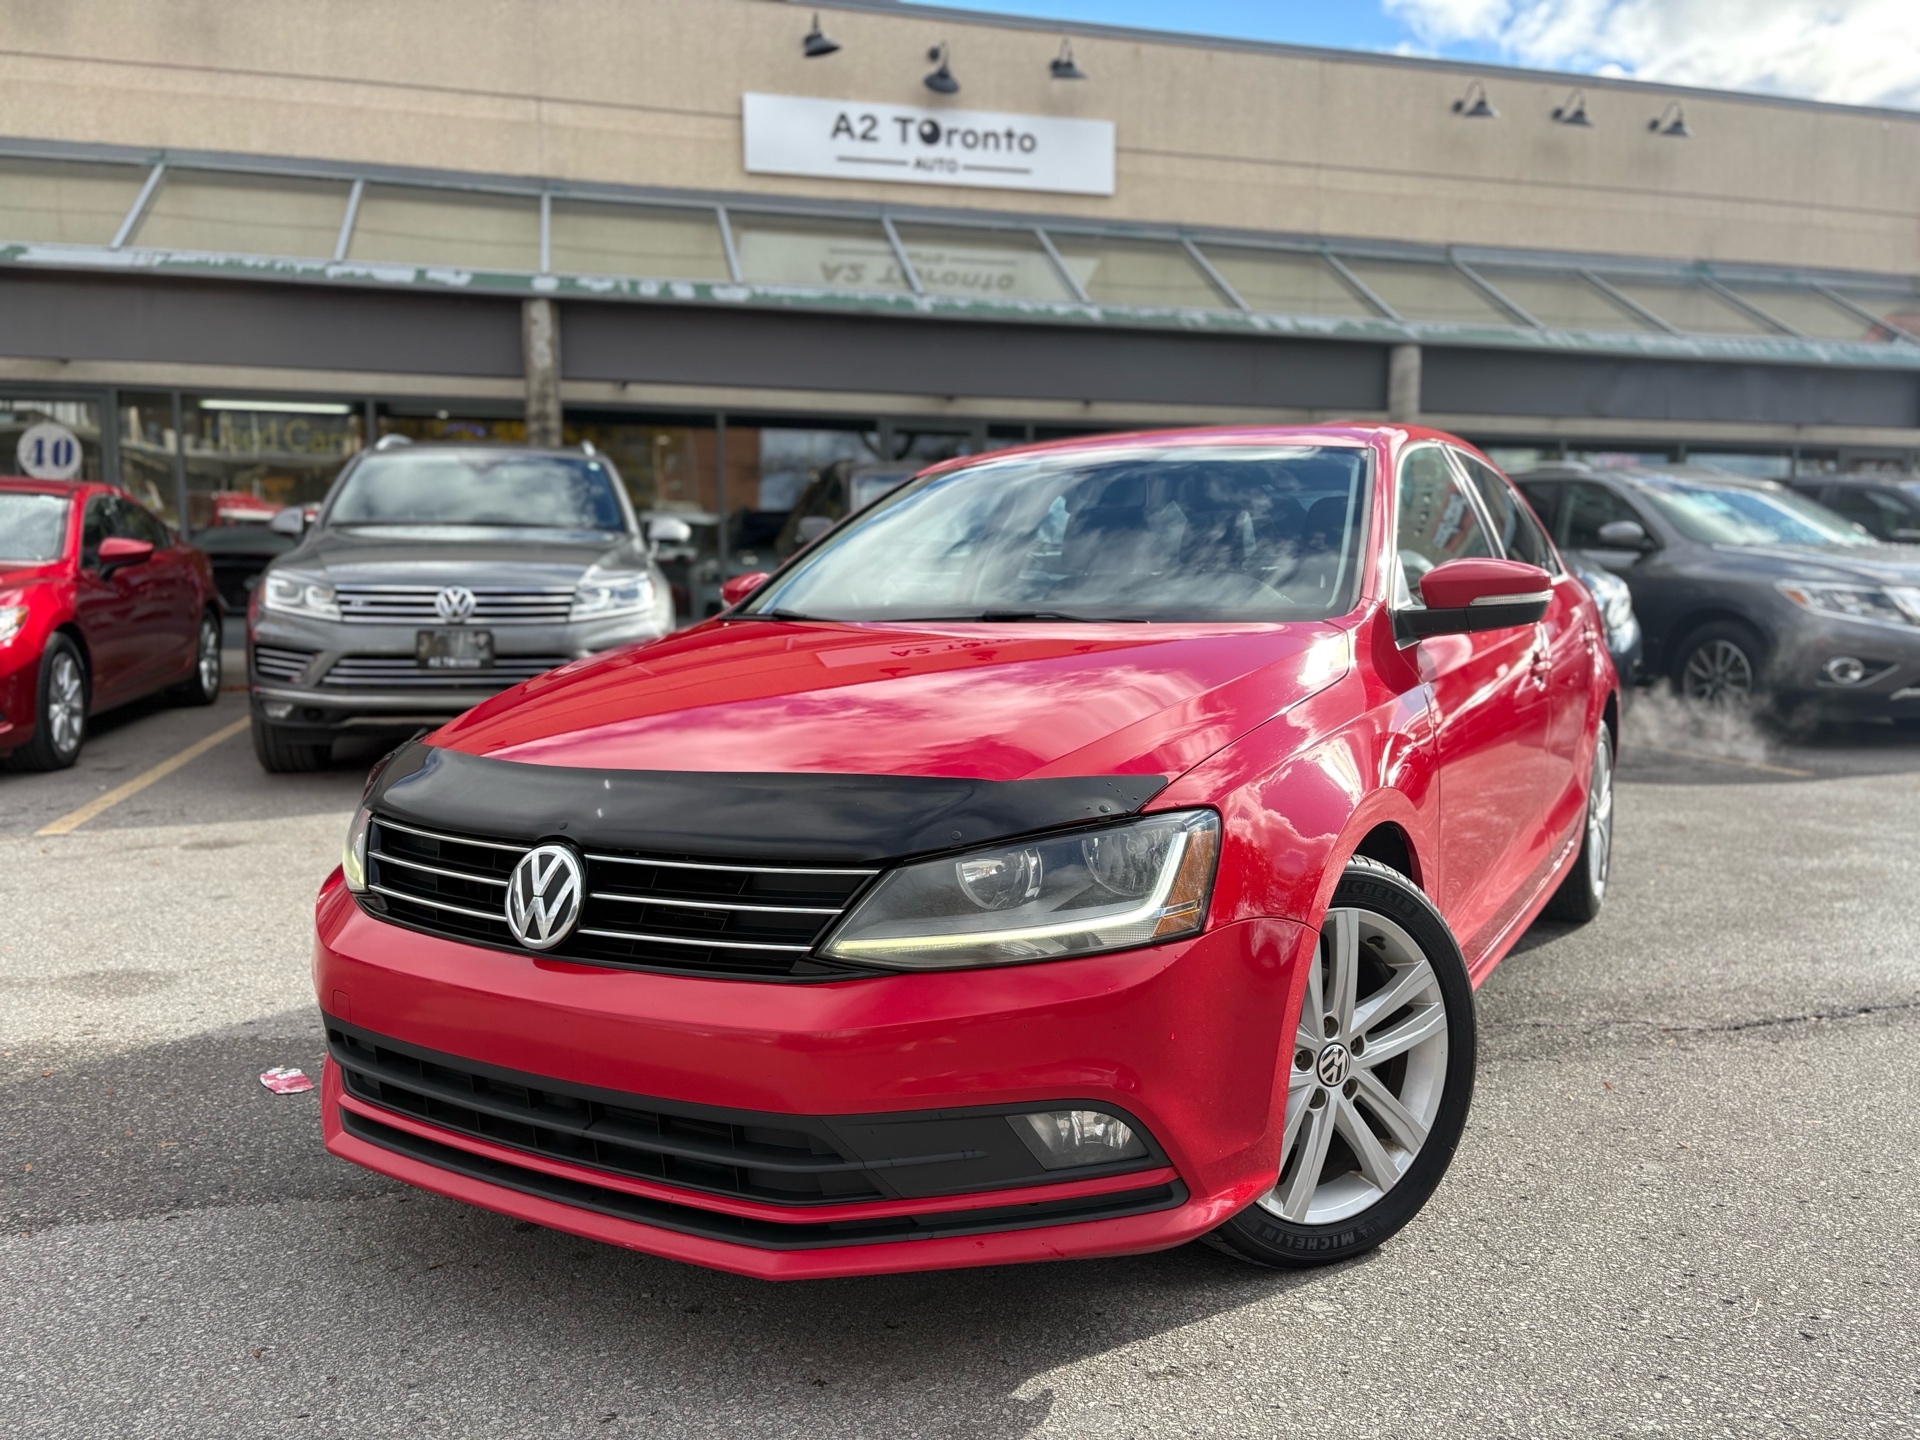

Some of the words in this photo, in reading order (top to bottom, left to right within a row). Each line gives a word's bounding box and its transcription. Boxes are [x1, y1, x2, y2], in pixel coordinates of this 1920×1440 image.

[831, 112, 879, 143] A2
[913, 157, 958, 174] AUTO
[26, 437, 73, 468] 40
[505, 845, 582, 950] VW
[1337, 881, 1414, 914] ICHELIN
[1262, 1226, 1355, 1250] MICHELIN
